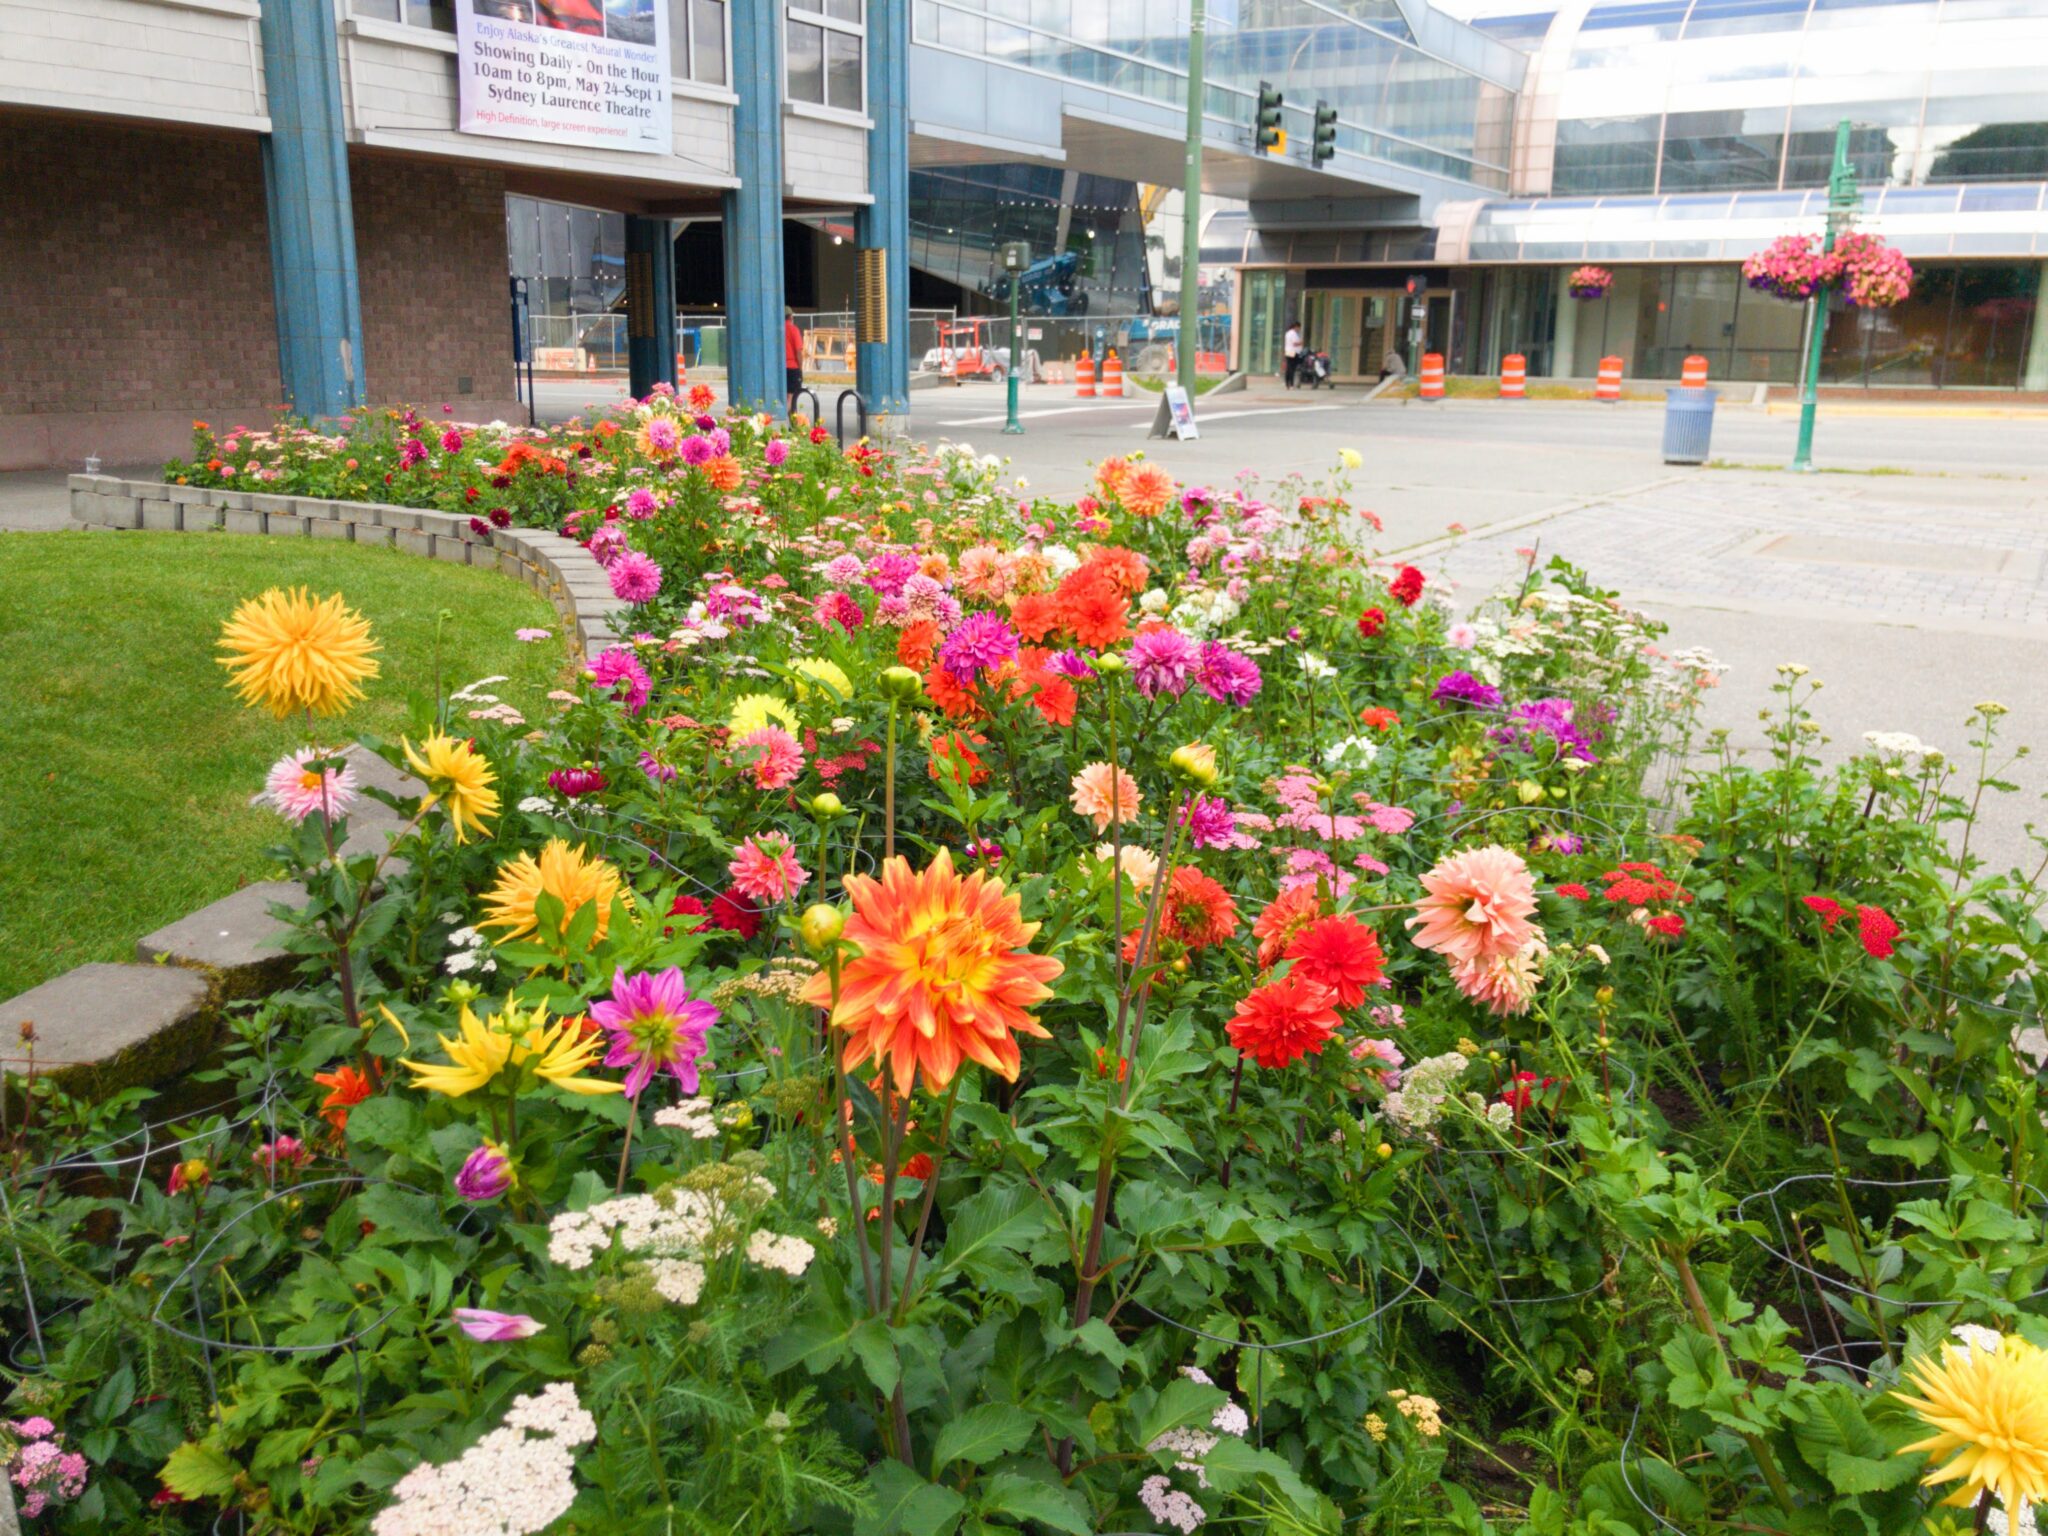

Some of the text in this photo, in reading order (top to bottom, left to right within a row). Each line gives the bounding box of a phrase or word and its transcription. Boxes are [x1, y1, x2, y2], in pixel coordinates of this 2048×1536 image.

[477, 22, 504, 39] Enjoy
[507, 28, 548, 44] Alaska's
[550, 35, 588, 52] Greatest
[591, 43, 621, 58] Natural
[474, 40, 535, 68] Showing
[540, 52, 572, 73] Daily
[586, 60, 603, 75] On
[607, 64, 627, 78] the
[631, 67, 659, 83] Hour
[474, 62, 512, 80] 10am
[517, 69, 532, 83] to
[537, 72, 571, 90] 8pm,
[576, 78, 600, 96] May
[656, 89, 662, 102] 1
[488, 84, 651, 118] Sydney Laurence Theatre
[476, 110, 496, 124] High
[498, 112, 539, 128] Definition,
[541, 117, 560, 131] large
[562, 121, 586, 133] screen
